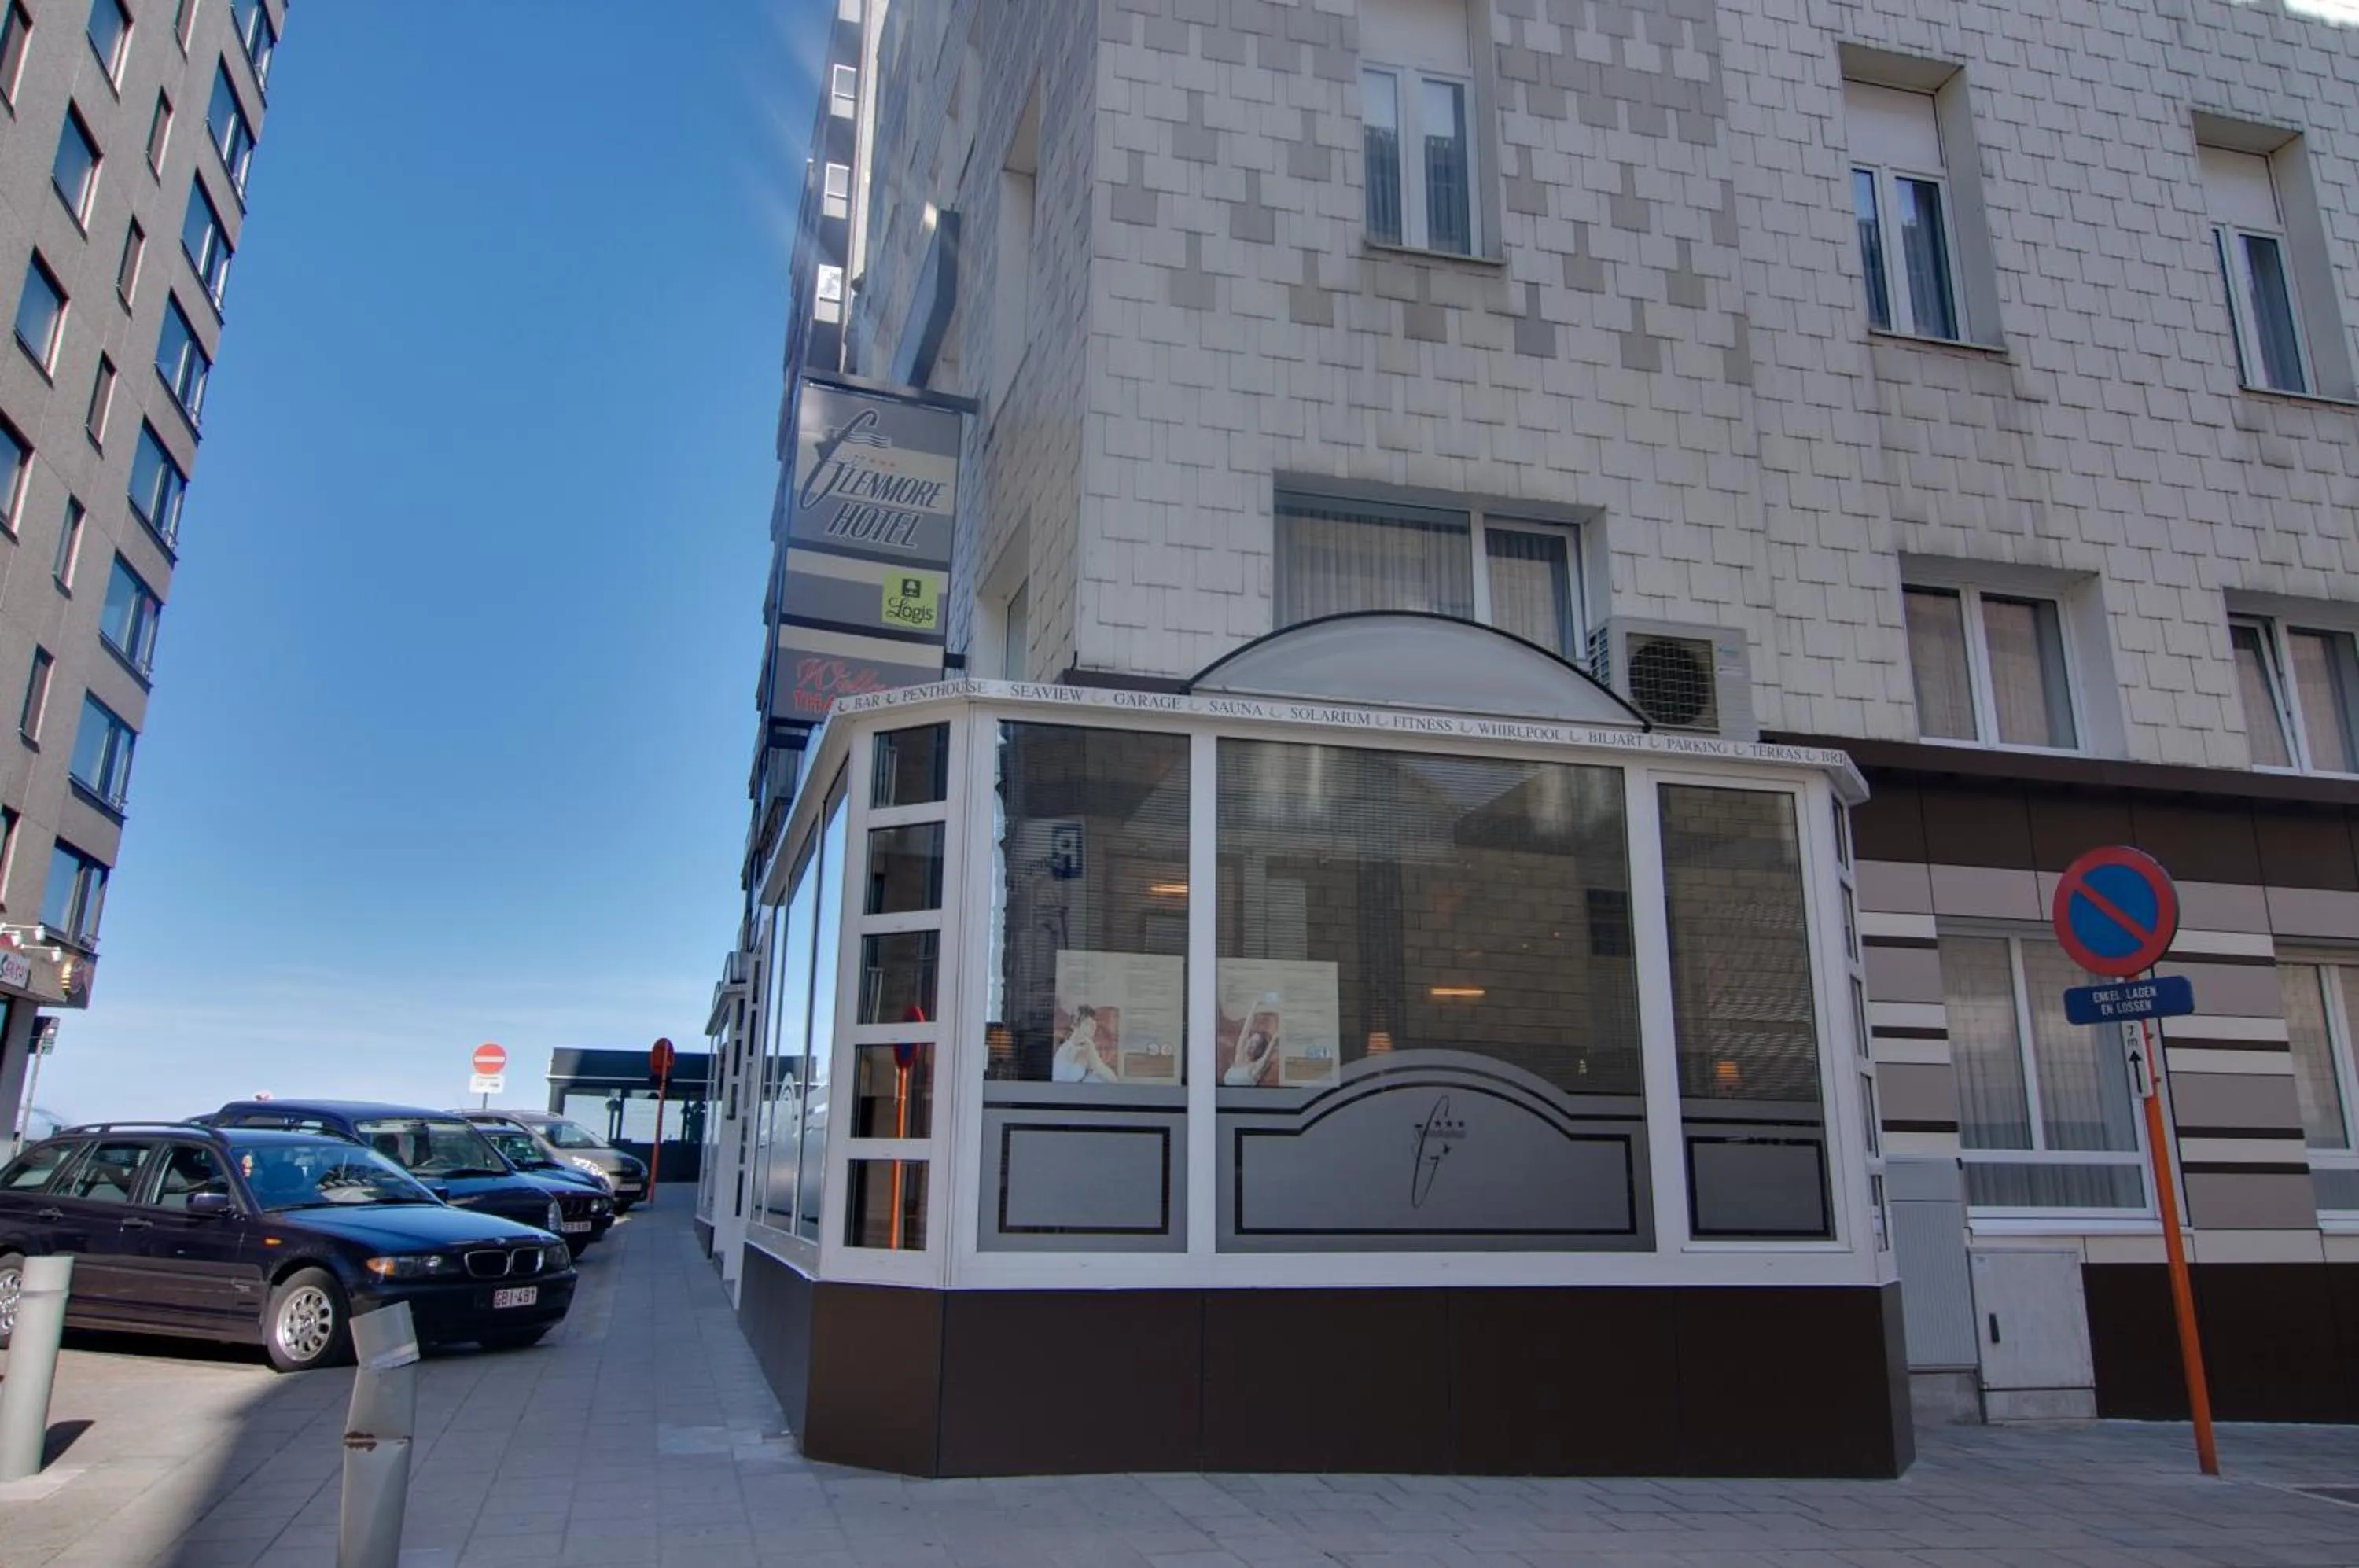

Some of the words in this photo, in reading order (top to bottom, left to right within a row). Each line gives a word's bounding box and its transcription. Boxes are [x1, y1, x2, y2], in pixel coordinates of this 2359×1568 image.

[800, 408, 948, 510] GLENMORE
[826, 502, 923, 548] HOTEL
[885, 596, 933, 624] Logis
[855, 694, 881, 709] BAR
[903, 680, 987, 702] PENTHOUSE
[1010, 685, 1084, 703] SEAVIEW
[1114, 692, 1181, 710] GARAGE
[1209, 699, 1263, 716] SAUNA
[1290, 706, 1371, 726] SOLARIUM
[1393, 715, 1453, 732] FITNESS
[1478, 722, 1561, 741] WHIRLPOOL
[1588, 730, 1643, 747] BILJART
[1665, 738, 1728, 755] PARKING
[1748, 744, 1801, 760] TERRAS
[2116, 999, 2152, 1014] LOSSEN
[2125, 985, 2157, 999] LADEN
